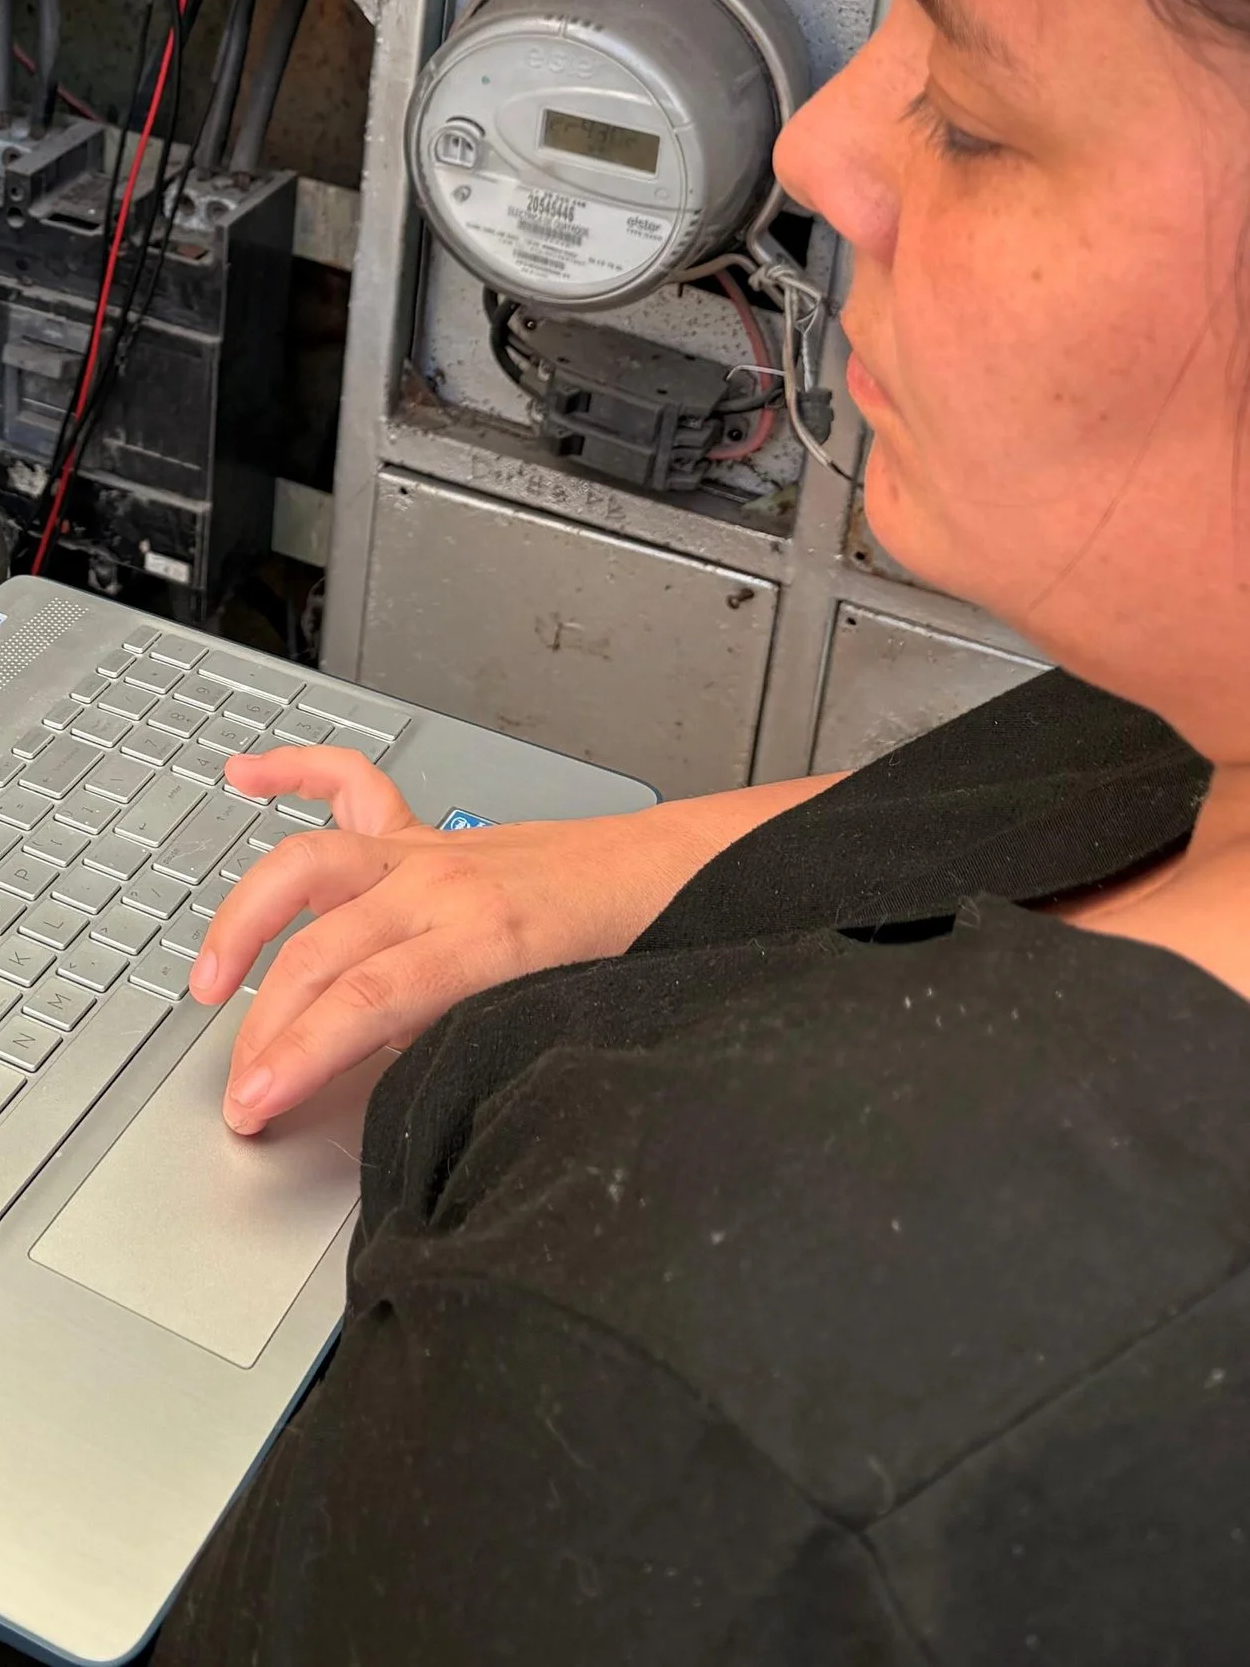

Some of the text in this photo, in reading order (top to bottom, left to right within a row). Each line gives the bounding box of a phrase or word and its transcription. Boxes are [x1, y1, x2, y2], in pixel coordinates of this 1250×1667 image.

[14, 868, 29, 881] P
[43, 919, 64, 930] L
[8, 951, 31, 966] K
[47, 992, 72, 1010] M
[12, 1031, 37, 1049] N
